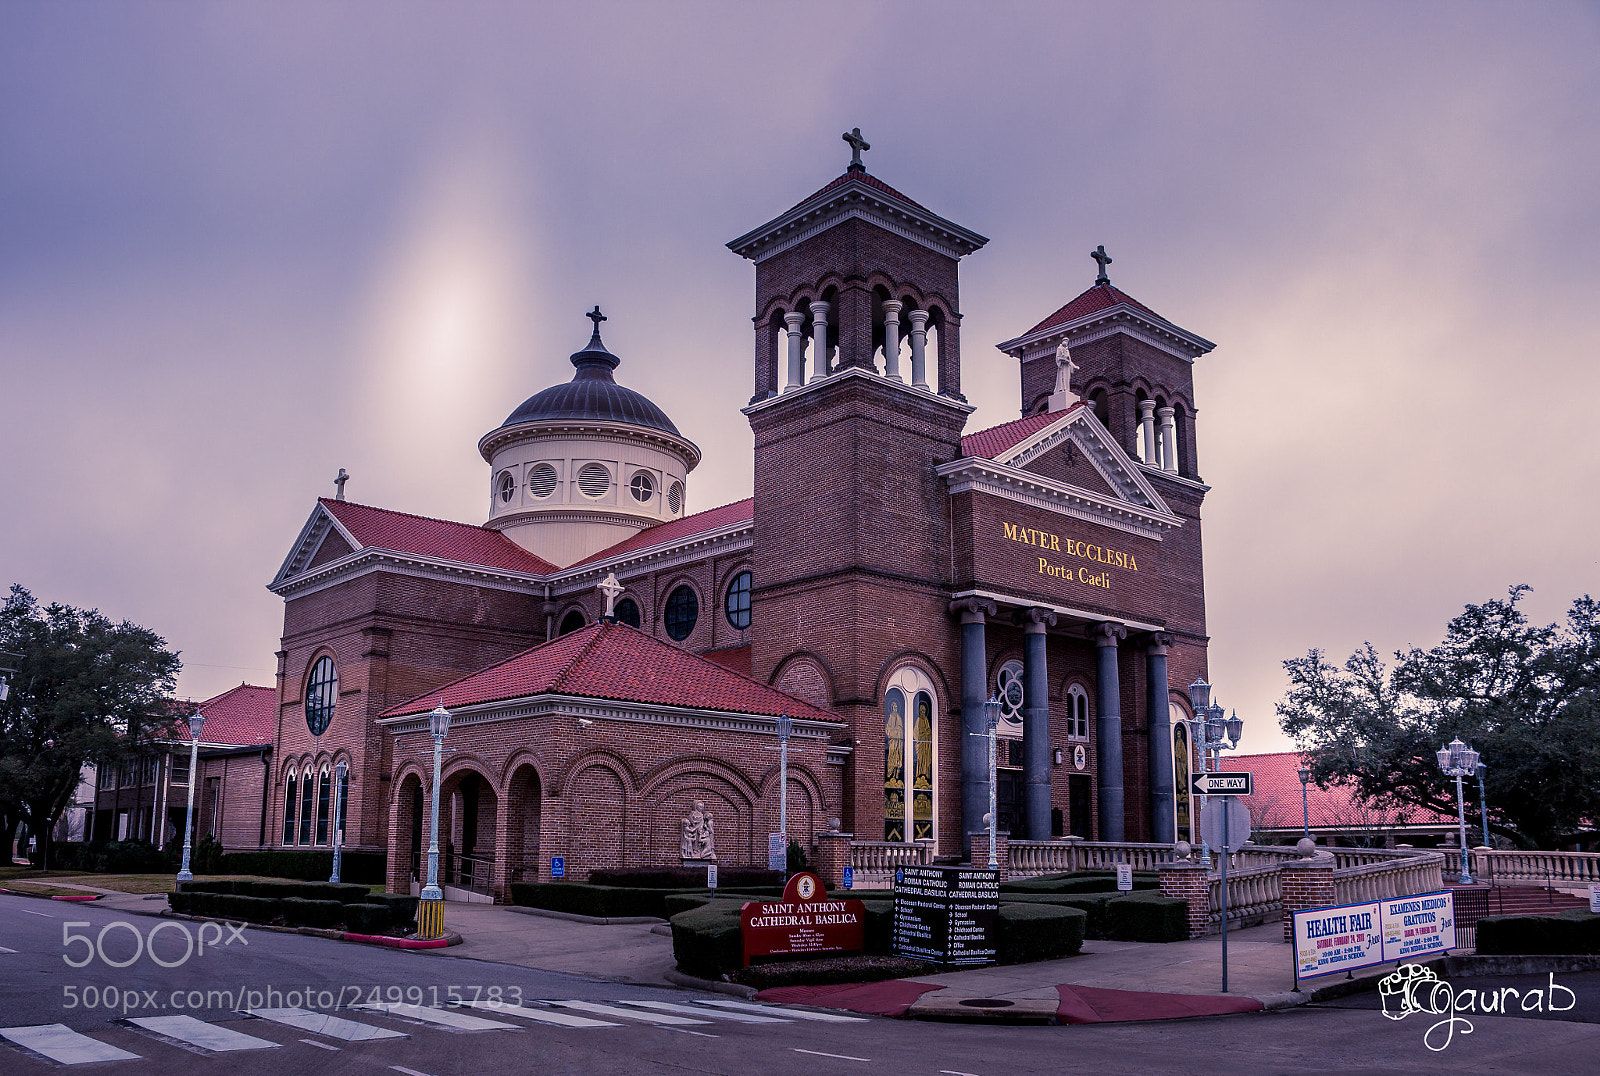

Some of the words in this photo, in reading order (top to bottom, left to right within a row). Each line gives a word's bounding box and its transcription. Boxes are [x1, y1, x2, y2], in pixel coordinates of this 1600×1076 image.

[1003, 522, 1061, 552] MATER
[1066, 538, 1138, 571] ECCLESIA
[1038, 557, 1074, 581] Porta
[1078, 567, 1110, 589] Caeli
[1208, 779, 1225, 788] ONE
[1226, 779, 1244, 788] WAY
[904, 868, 919, 876] SAINT
[919, 870, 943, 878] ANTHONY
[958, 872, 973, 880] SAINT
[973, 872, 996, 880] ANTHONY
[904, 877, 922, 886] ROMAN
[922, 879, 948, 888] CATHOLIC
[958, 881, 976, 889] ROMAN
[895, 885, 923, 896] CATHEDRAL
[923, 888, 947, 898] BASILICA
[948, 890, 978, 899] CATHEDRAL
[977, 891, 999, 899] BASILICA
[762, 903, 795, 915] SAINT
[796, 902, 847, 914] ANTHONY
[1389, 901, 1421, 916] EXAMENES
[1421, 897, 1447, 911] MEDICOS
[750, 915, 813, 927] CATHEDRAL
[815, 913, 858, 925] BASILICA
[1403, 911, 1437, 927] GRATUITOS
[1306, 916, 1347, 939] HEALTH
[1349, 913, 1372, 932] FAIR
[1333, 948, 1341, 956] AM
[1410, 944, 1427, 952] MIDDLE
[1427, 940, 1444, 949] SCHOOL
[1317, 958, 1329, 966] KING
[1329, 955, 1347, 963] MIDDLE
[1347, 951, 1366, 960] SCHOOL
